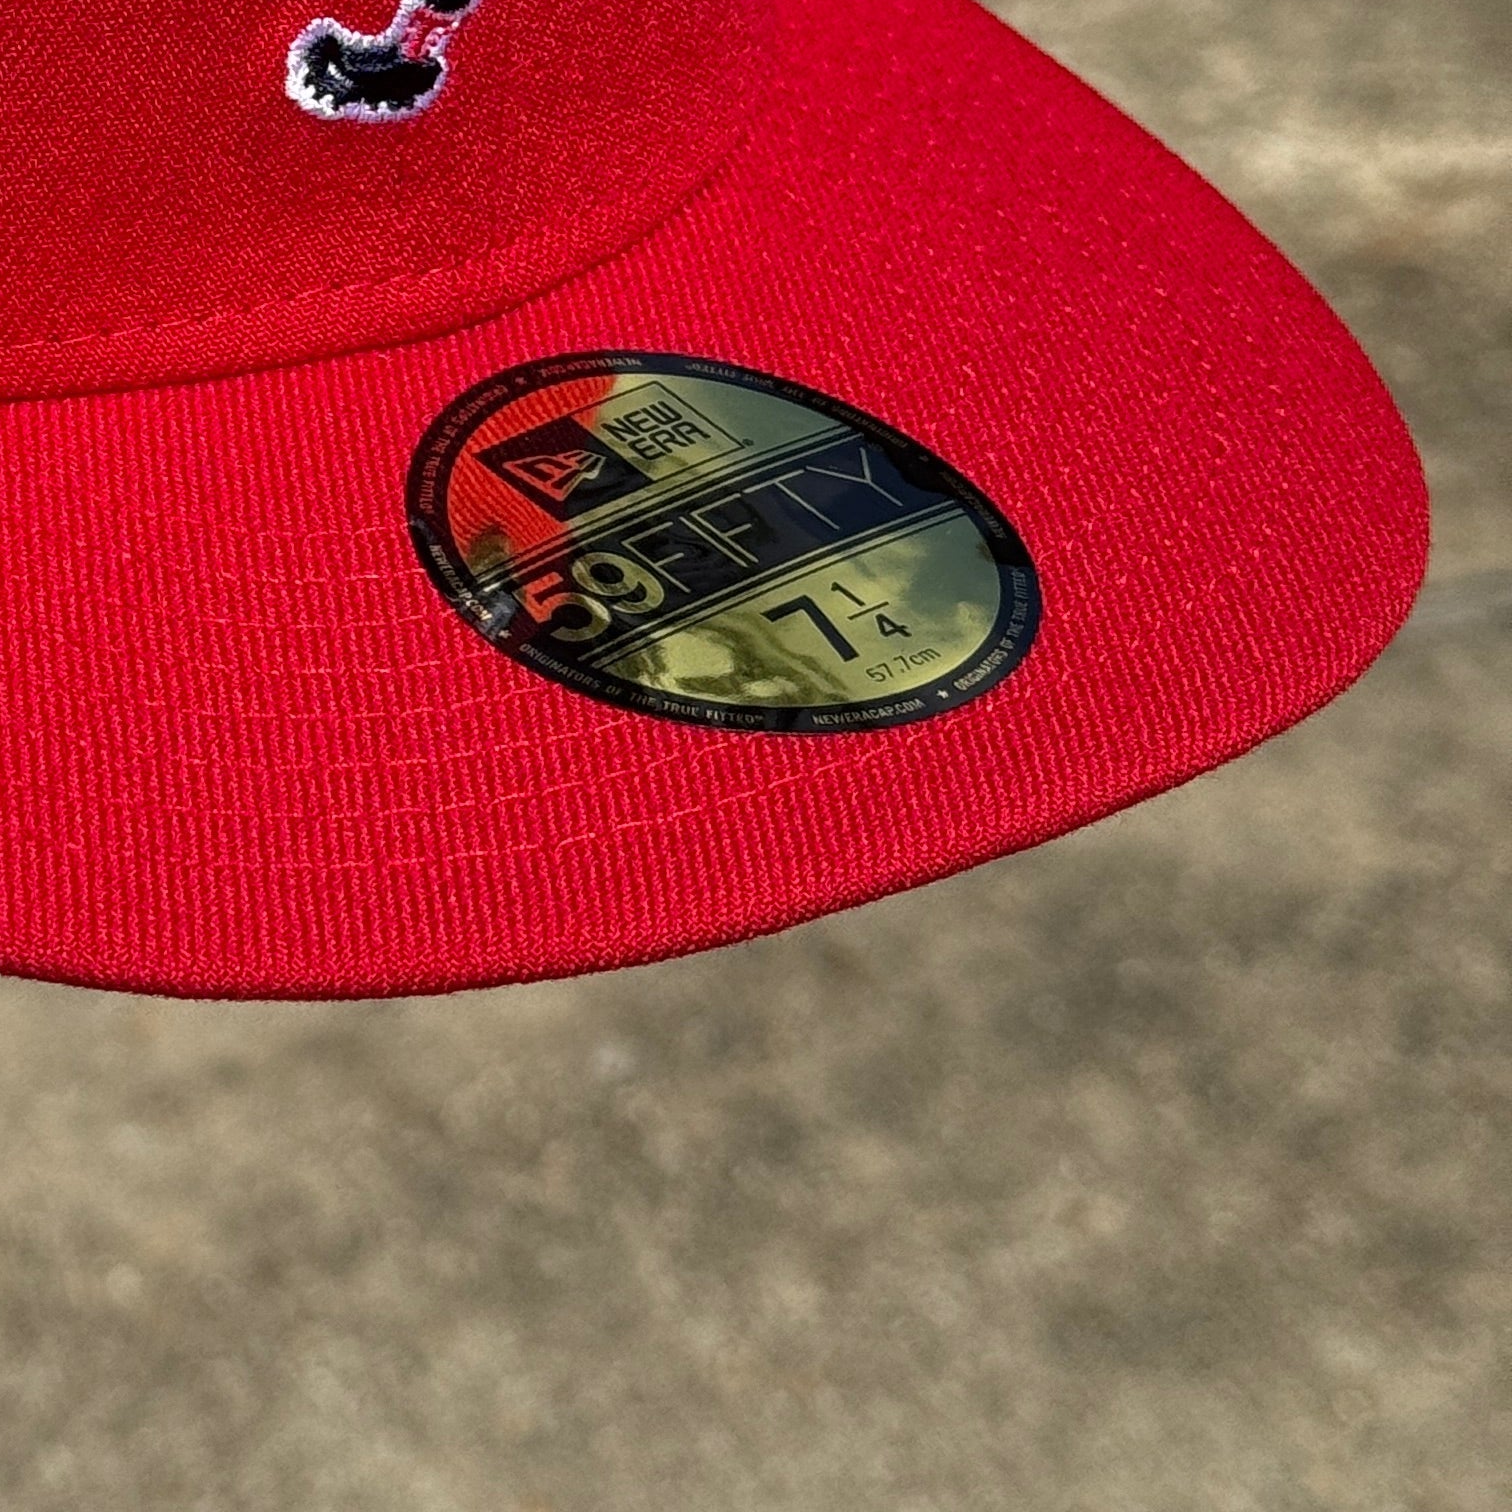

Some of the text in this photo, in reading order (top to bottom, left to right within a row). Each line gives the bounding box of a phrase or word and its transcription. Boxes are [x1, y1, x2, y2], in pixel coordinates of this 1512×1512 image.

[600, 400, 683, 442] NEW
[627, 421, 712, 461] ERA
[514, 447, 905, 643] 59FIFTY
[759, 594, 861, 663] 7
[518, 642, 602, 690] ORIGINATORS
[865, 646, 942, 683] 57.7cm
[812, 697, 927, 726] NEWERACAP.COM
